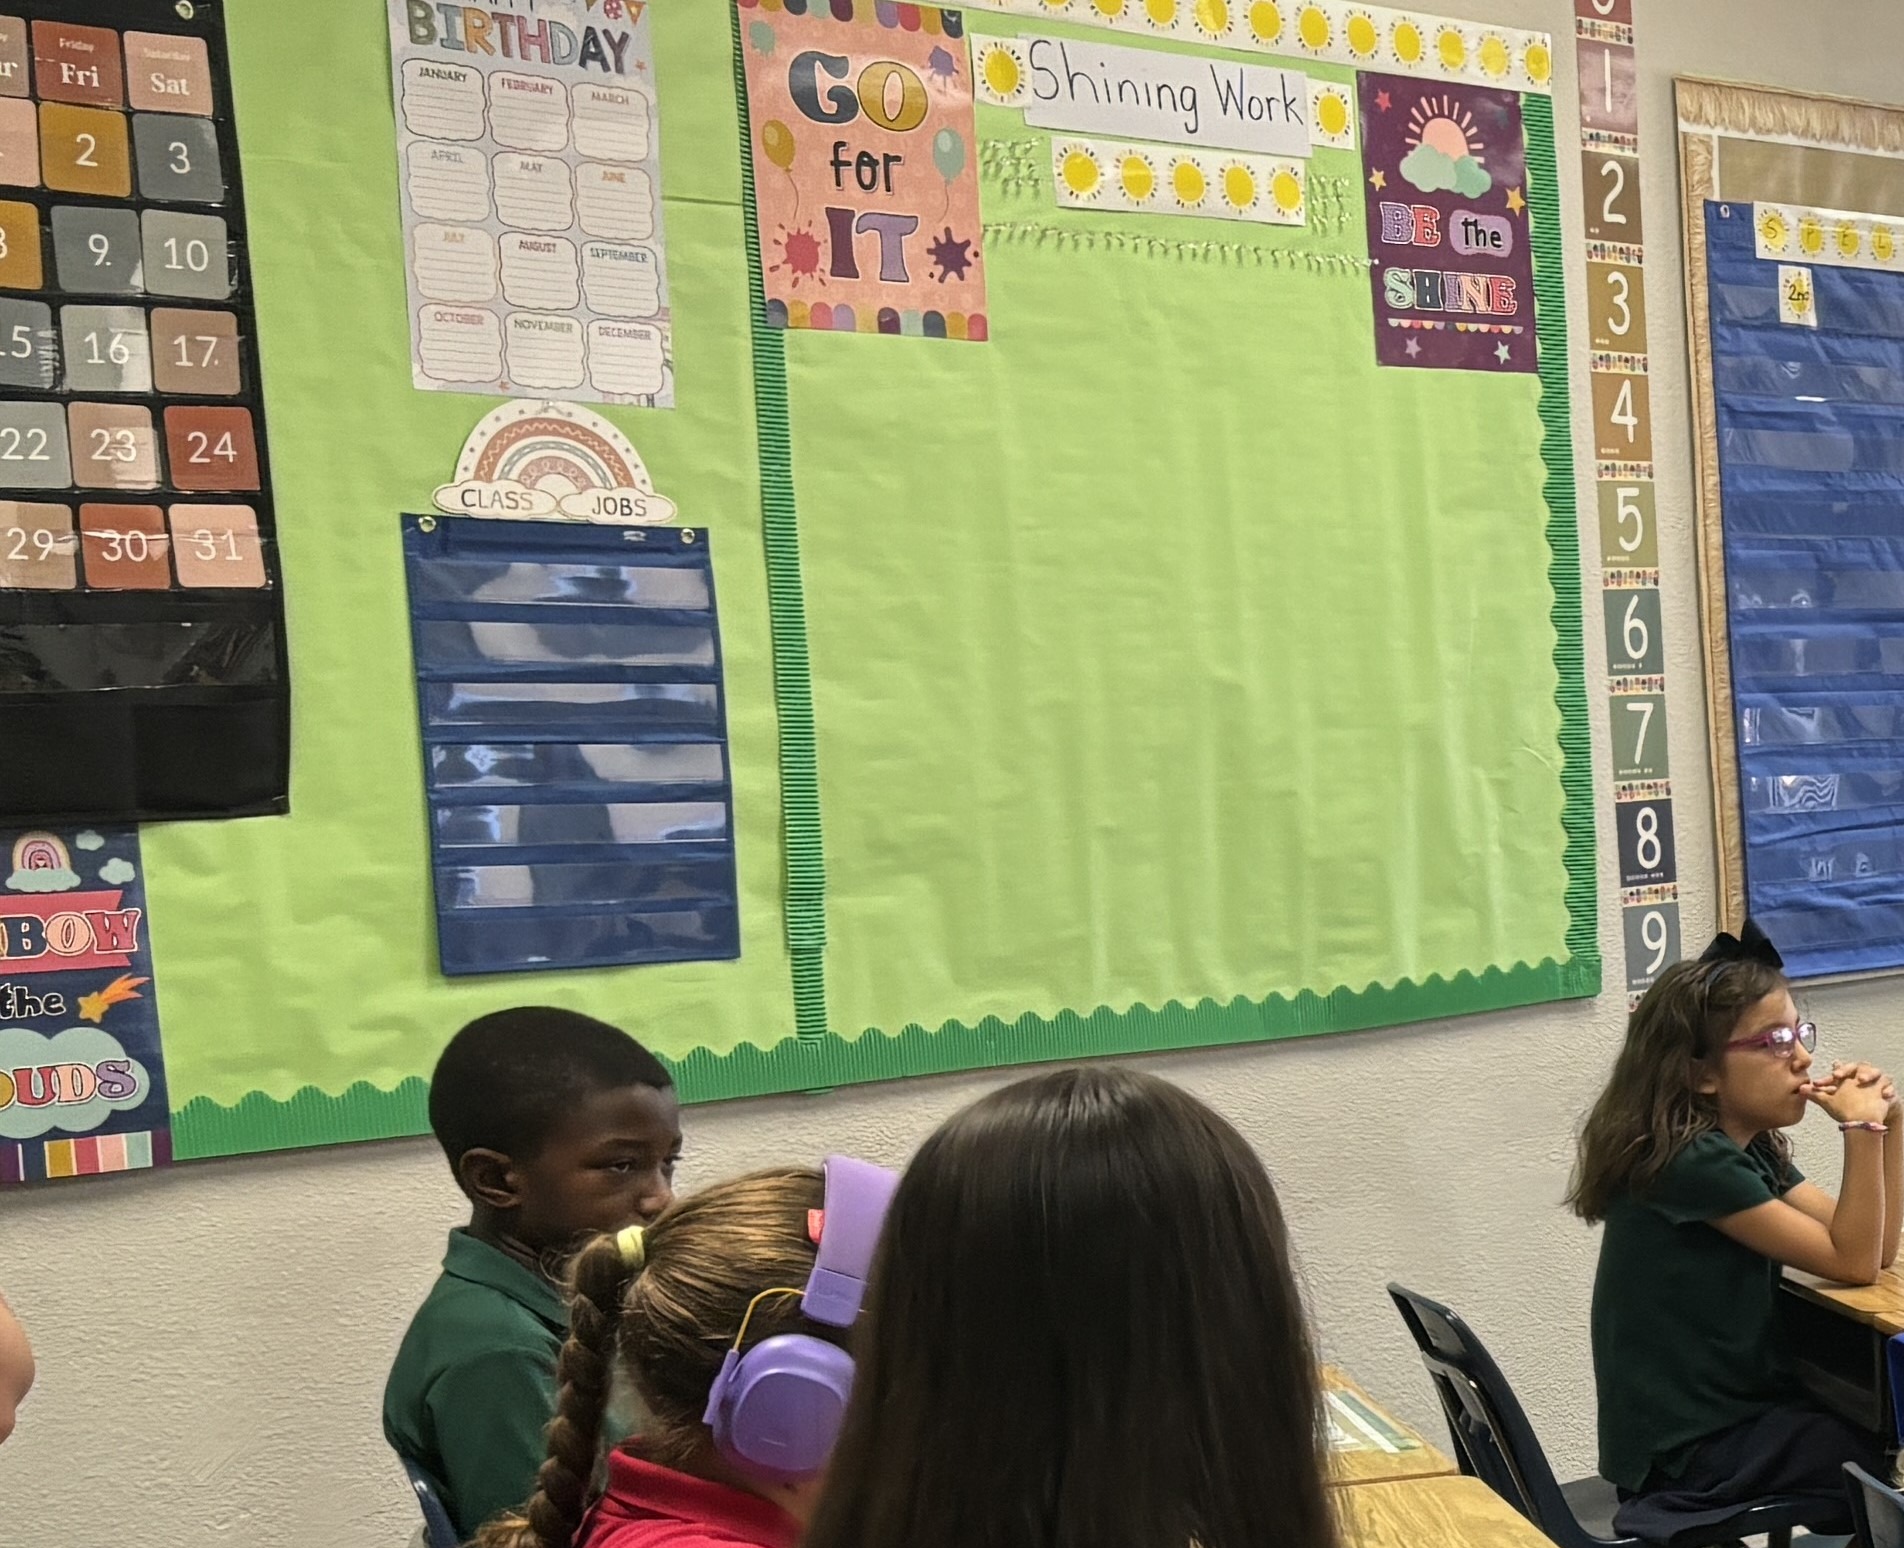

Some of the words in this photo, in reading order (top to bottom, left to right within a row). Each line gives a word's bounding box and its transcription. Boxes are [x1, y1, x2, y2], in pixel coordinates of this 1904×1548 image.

[59, 37, 95, 53] Friday
[407, 0, 631, 75] BIRTHDAY
[60, 62, 100, 88] Fri
[150, 72, 190, 96] Sat
[788, 49, 930, 133] GO
[1029, 38, 1200, 135] Shining
[1209, 63, 1305, 126] Work
[1604, 48, 1613, 114] 1
[75, 133, 98, 167] 2
[168, 142, 191, 174] 3
[828, 140, 905, 195] for
[1600, 158, 1628, 226] 2
[824, 206, 920, 284] IT
[1379, 201, 1442, 248] BE
[1460, 216, 1504, 249] the
[164, 237, 209, 272] 10
[1383, 266, 1518, 316] SHINE
[1606, 270, 1631, 336] 3
[0, 326, 31, 359] 5
[84, 332, 130, 365] 16
[513, 318, 574, 334] NOVEMBER
[598, 325, 653, 341] DECEMBER
[1610, 379, 1639, 444] 4
[0, 427, 50, 460] 22
[90, 428, 137, 462] 23
[187, 431, 237, 464] 24
[460, 488, 534, 512] CLASS
[591, 496, 648, 517] JOBS
[1615, 487, 1644, 553] 5
[7, 527, 54, 561] 29
[102, 529, 148, 562] 30
[194, 528, 244, 561] 31
[1622, 594, 1649, 660] 6
[1625, 702, 1654, 764] 7
[1635, 806, 1663, 870] 8
[0, 908, 142, 958] BOW
[1640, 910, 1667, 976] 9
